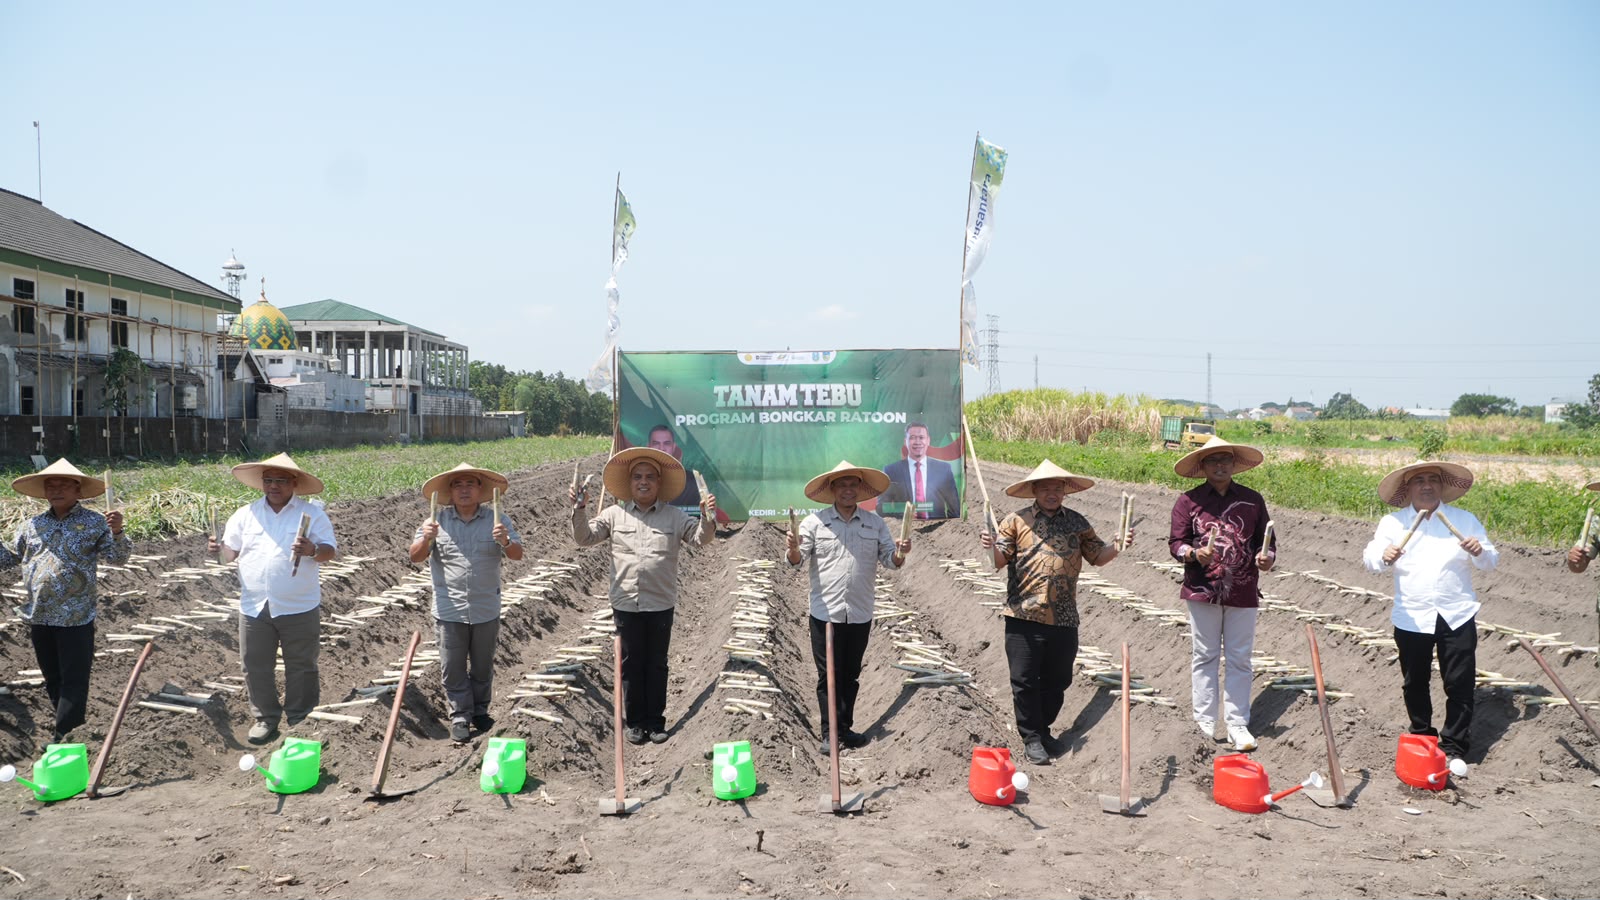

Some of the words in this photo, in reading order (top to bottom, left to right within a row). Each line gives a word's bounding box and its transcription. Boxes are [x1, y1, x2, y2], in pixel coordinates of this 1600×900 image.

[713, 383, 798, 408] TANAM
[800, 383, 862, 407] TEBU
[675, 411, 755, 427] PROGRAM
[759, 411, 836, 425] BONGKAR
[840, 411, 907, 424] RATOON
[748, 509, 776, 517] KEDIRI
